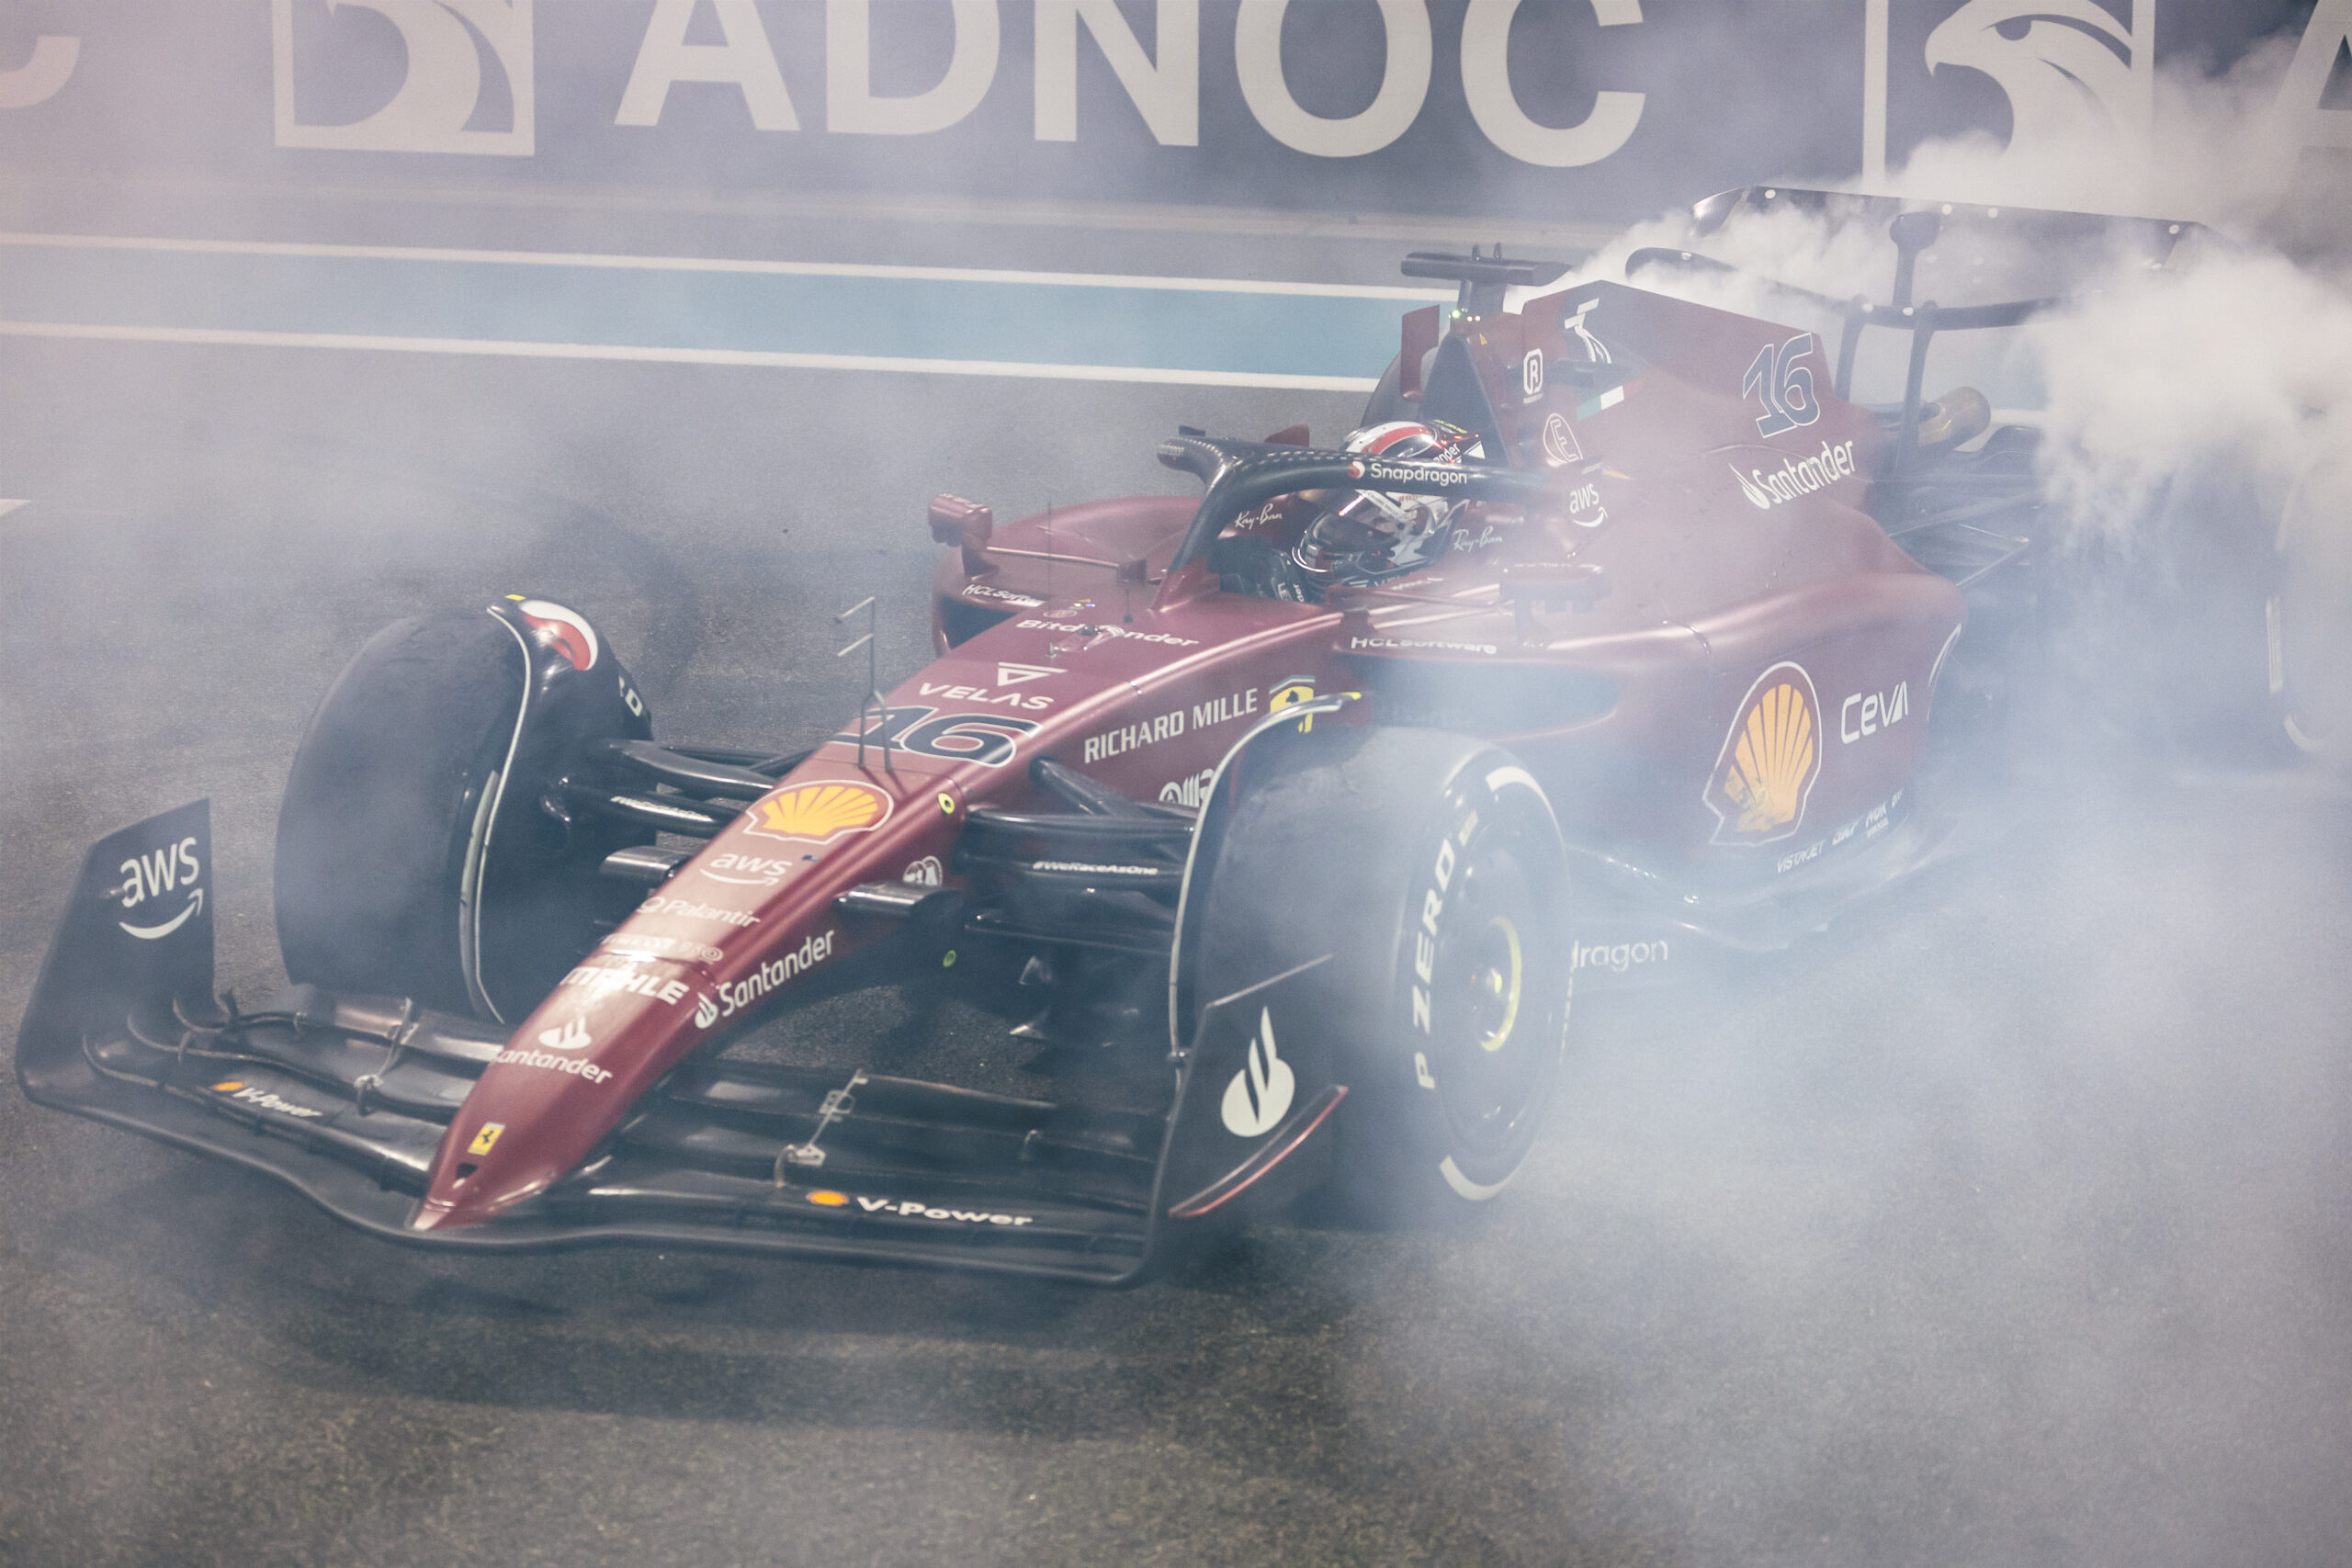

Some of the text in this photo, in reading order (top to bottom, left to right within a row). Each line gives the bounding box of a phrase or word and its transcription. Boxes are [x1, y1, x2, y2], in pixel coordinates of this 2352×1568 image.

[613, 0, 1645, 167] ADNOC
[1742, 332, 1821, 438] 16
[1370, 462, 1468, 487] Snapdragon
[1752, 440, 1856, 504] Santander
[1569, 483, 1600, 514] aws
[1452, 525, 1503, 553] Ray-Ban
[1016, 618, 1200, 647] Bitdnder
[919, 682, 1055, 710] VELAS
[826, 705, 1044, 768] 16
[1084, 687, 1259, 764] RICHARD MILLE
[119, 836, 200, 909] aws
[709, 852, 793, 877] aws
[661, 898, 762, 928] Palantir
[718, 930, 836, 1018] Santander
[1412, 838, 1456, 1090] P ZERO
[492, 1049, 614, 1084] antander
[232, 1087, 323, 1118] V-Power
[856, 1196, 1034, 1226] V-Power
